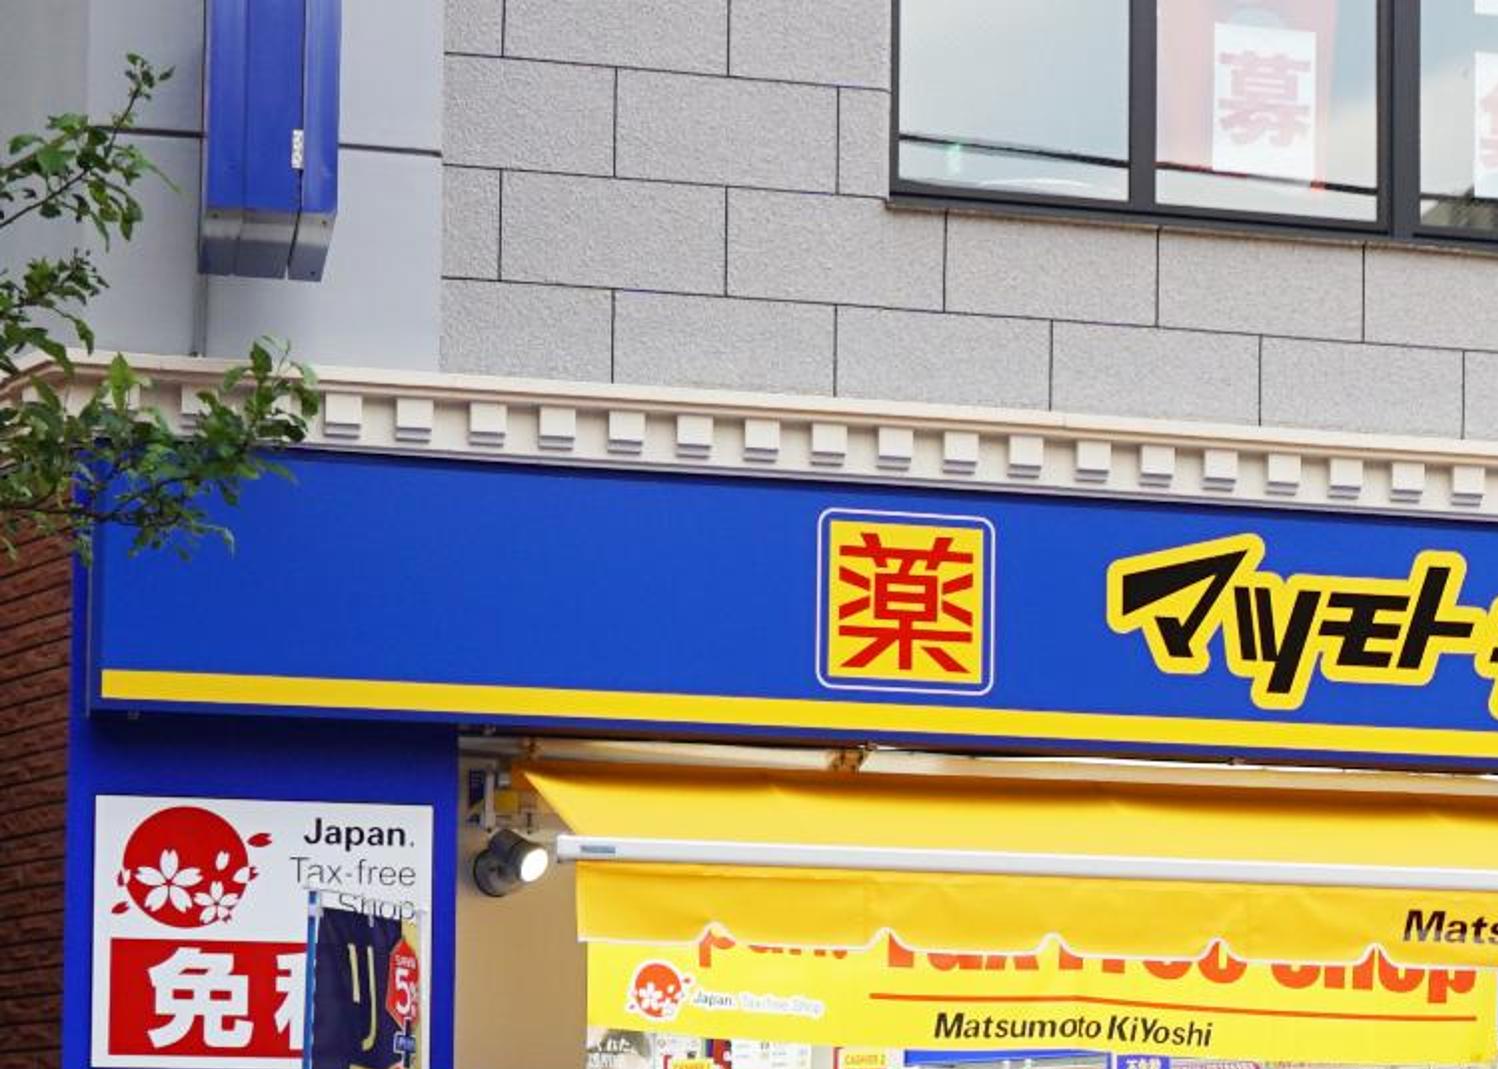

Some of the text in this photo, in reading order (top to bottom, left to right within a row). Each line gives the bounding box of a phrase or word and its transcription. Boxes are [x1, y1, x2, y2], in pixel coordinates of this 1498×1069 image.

[1219, 50, 1312, 147] 募
[836, 532, 975, 674] 薬
[303, 817, 415, 852] Japan.
[289, 856, 416, 886] Tax-free
[933, 1012, 1213, 1047] Matsumoto KiYoshi
